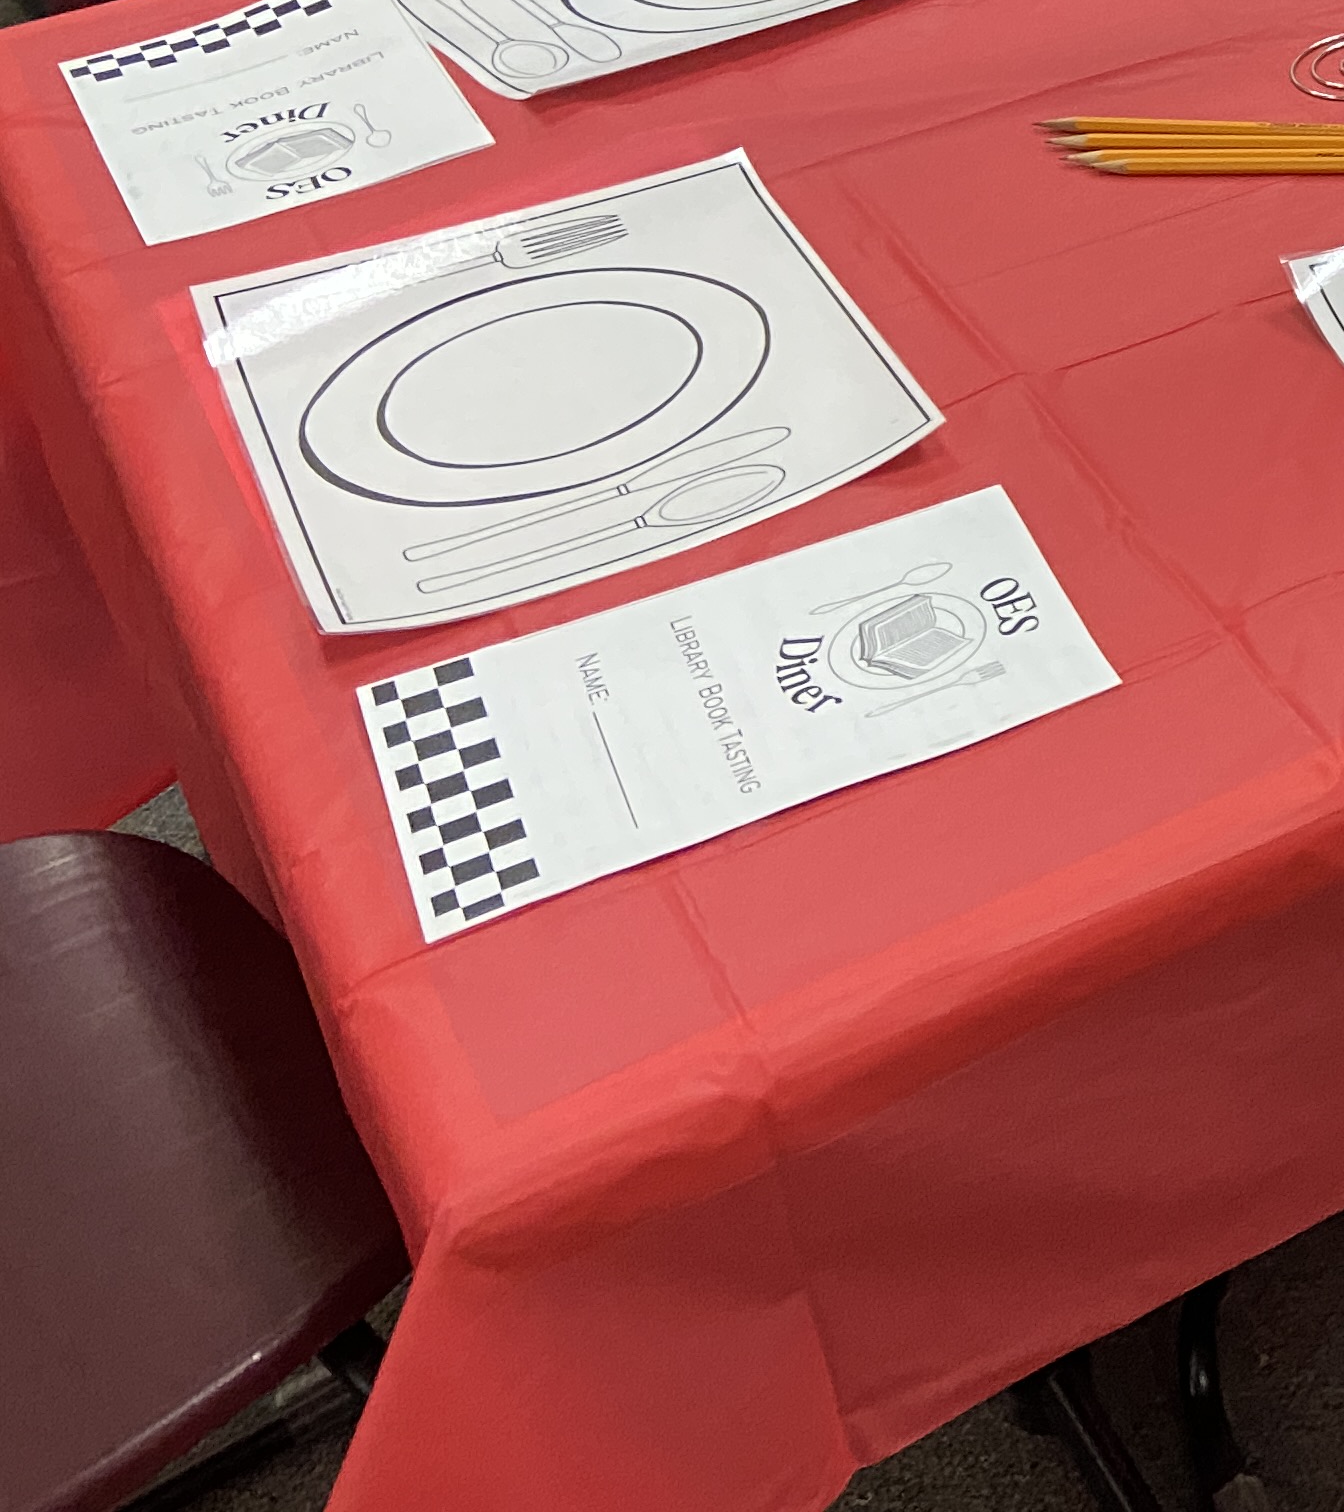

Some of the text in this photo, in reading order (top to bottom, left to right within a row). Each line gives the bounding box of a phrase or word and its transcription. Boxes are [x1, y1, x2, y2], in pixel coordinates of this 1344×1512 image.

[131, 51, 384, 136] LIBRARY BOOK TASTING
[219, 101, 331, 143] Diner
[265, 165, 353, 201] OES
[979, 576, 1040, 639] OES
[669, 614, 762, 795] LIBRARY BOOK TASTING
[775, 634, 843, 713] Diner
